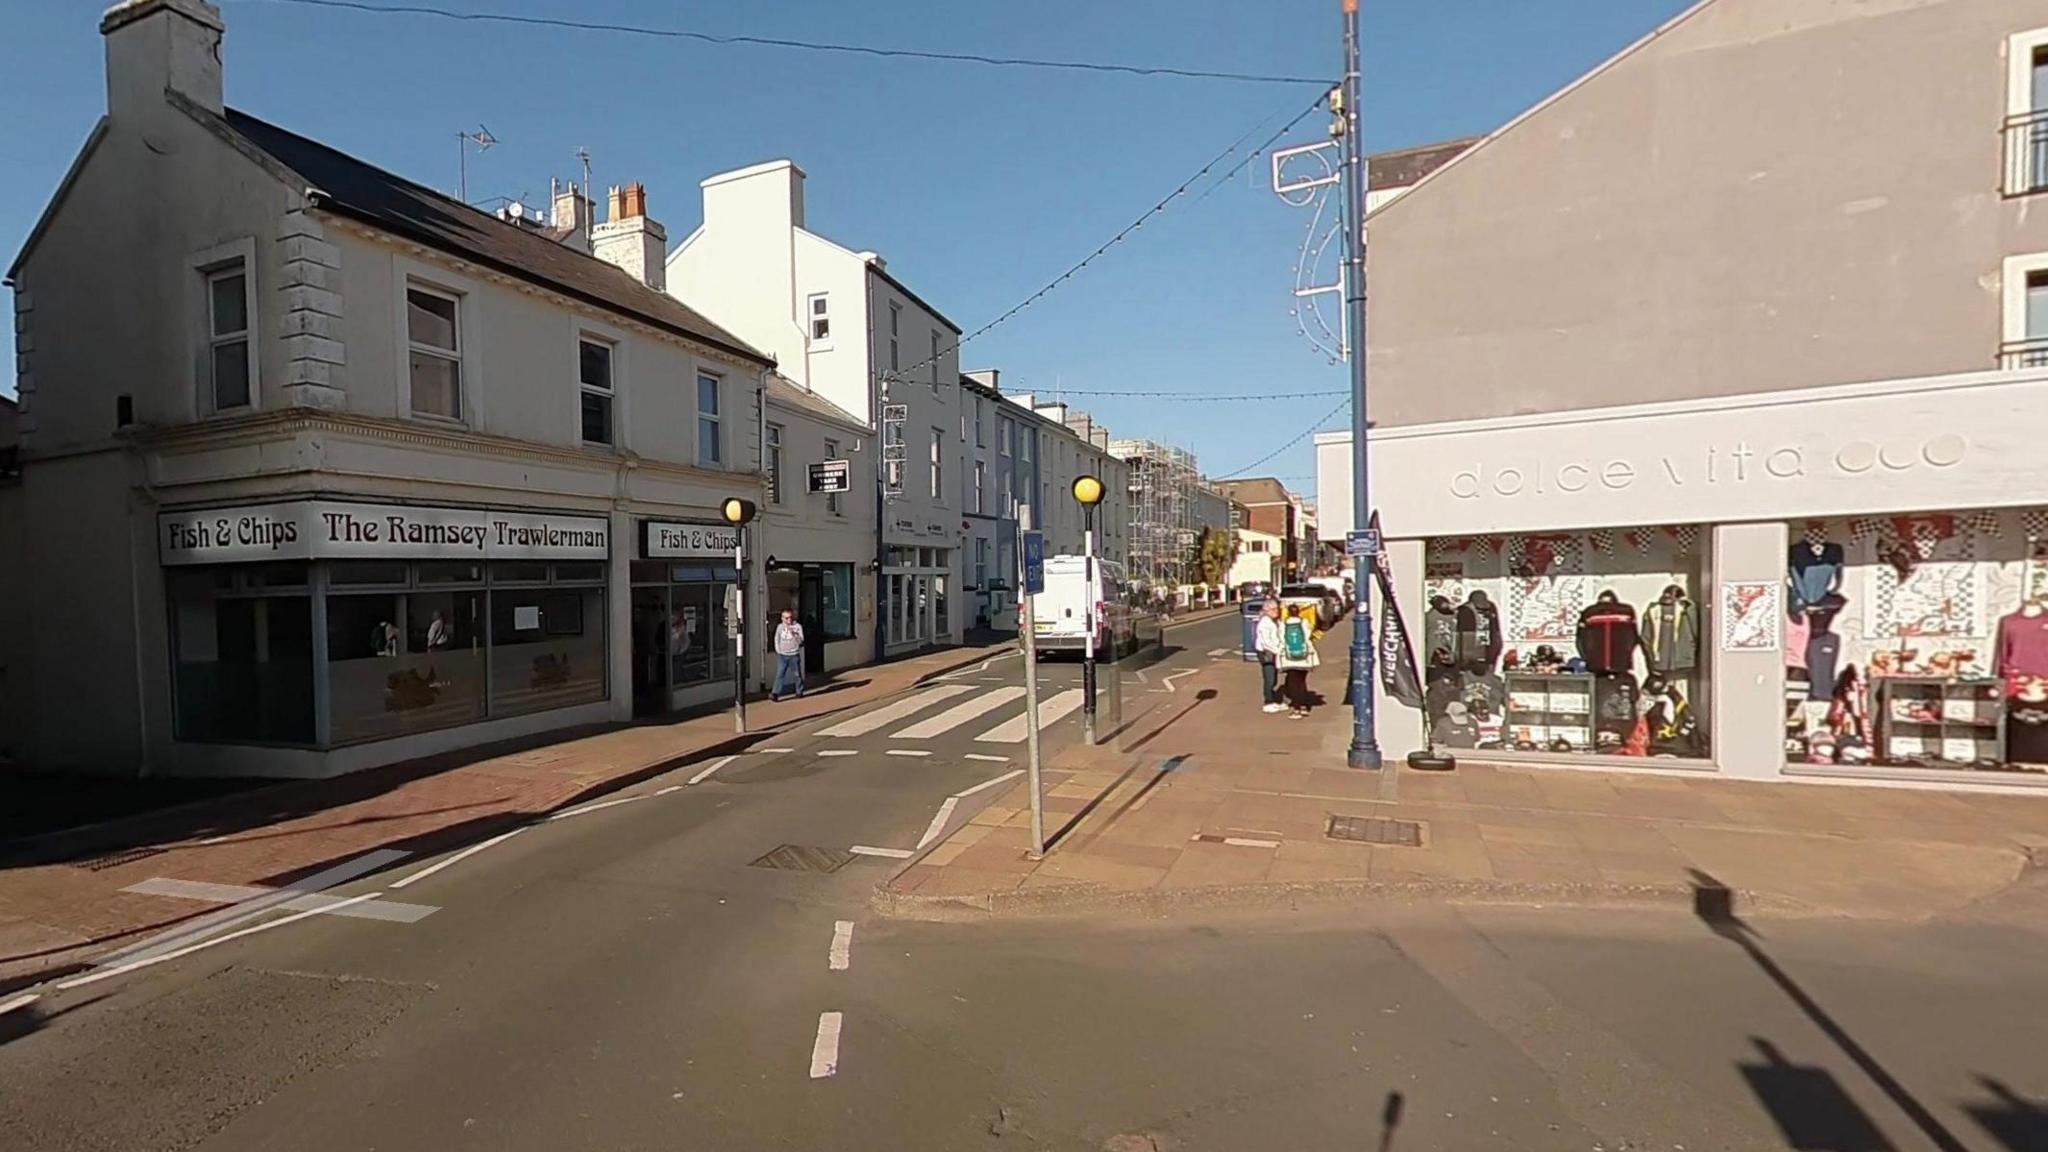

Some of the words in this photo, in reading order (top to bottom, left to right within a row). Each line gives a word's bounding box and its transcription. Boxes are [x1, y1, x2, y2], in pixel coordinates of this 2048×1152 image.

[1449, 461, 1634, 499] dolce
[168, 521, 210, 549] Fish
[216, 519, 231, 547] &
[237, 516, 298, 550] Chips
[321, 512, 379, 542] The
[386, 516, 487, 551] Ramsey
[492, 521, 606, 548] Trawlerman
[660, 529, 688, 549] Fish
[692, 530, 702, 549] &
[705, 531, 738, 554] Chips
